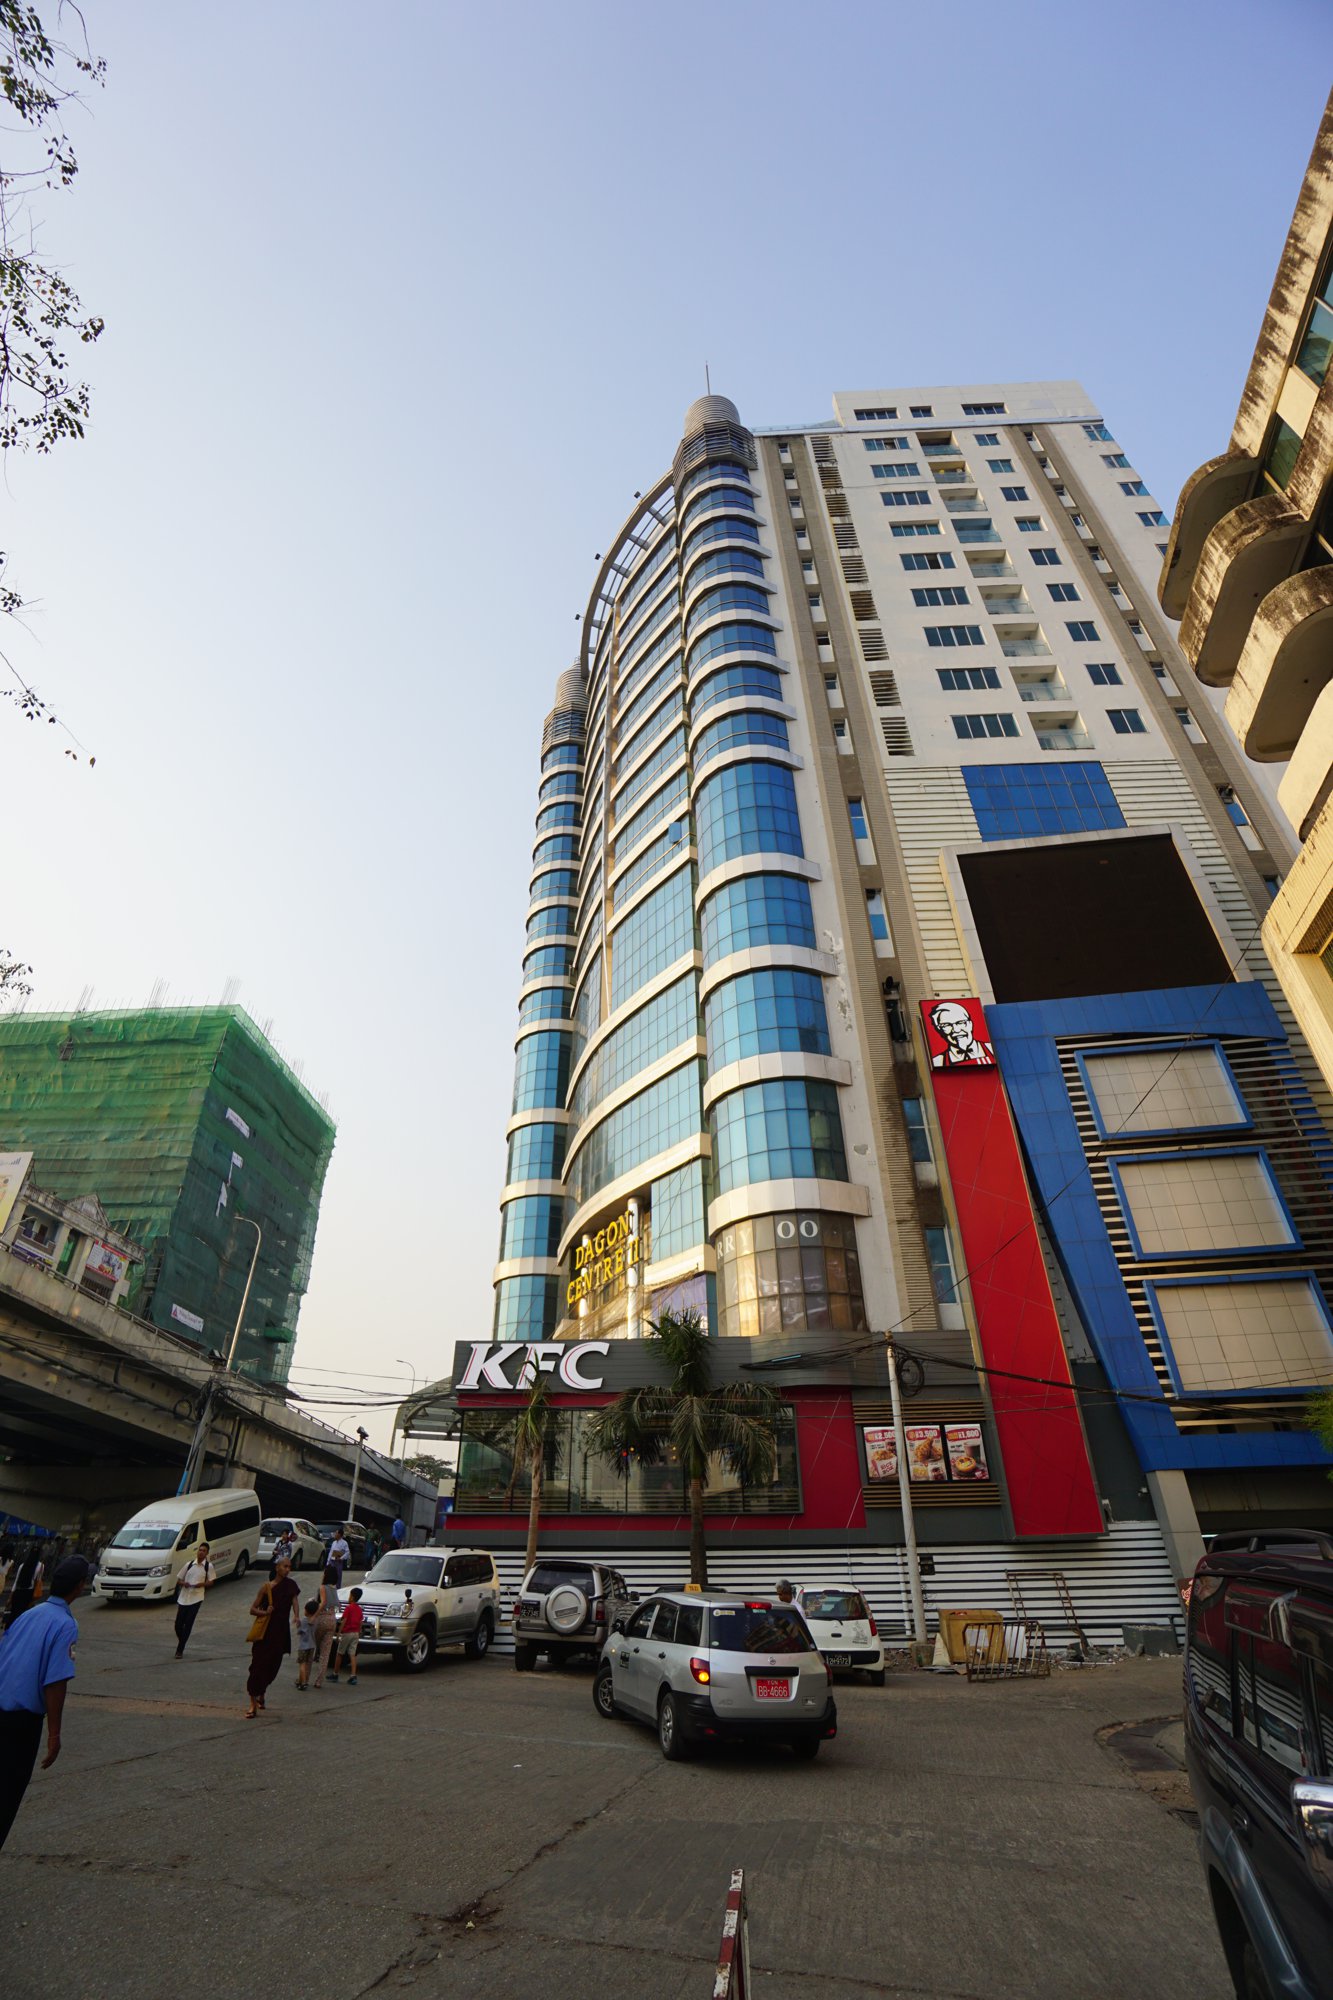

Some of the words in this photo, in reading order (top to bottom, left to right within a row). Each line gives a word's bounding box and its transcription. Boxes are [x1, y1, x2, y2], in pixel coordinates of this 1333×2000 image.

[575, 1210, 630, 1270] DAGON
[567, 1247, 623, 1304] CENTRE
[455, 1341, 610, 1390] KFC
